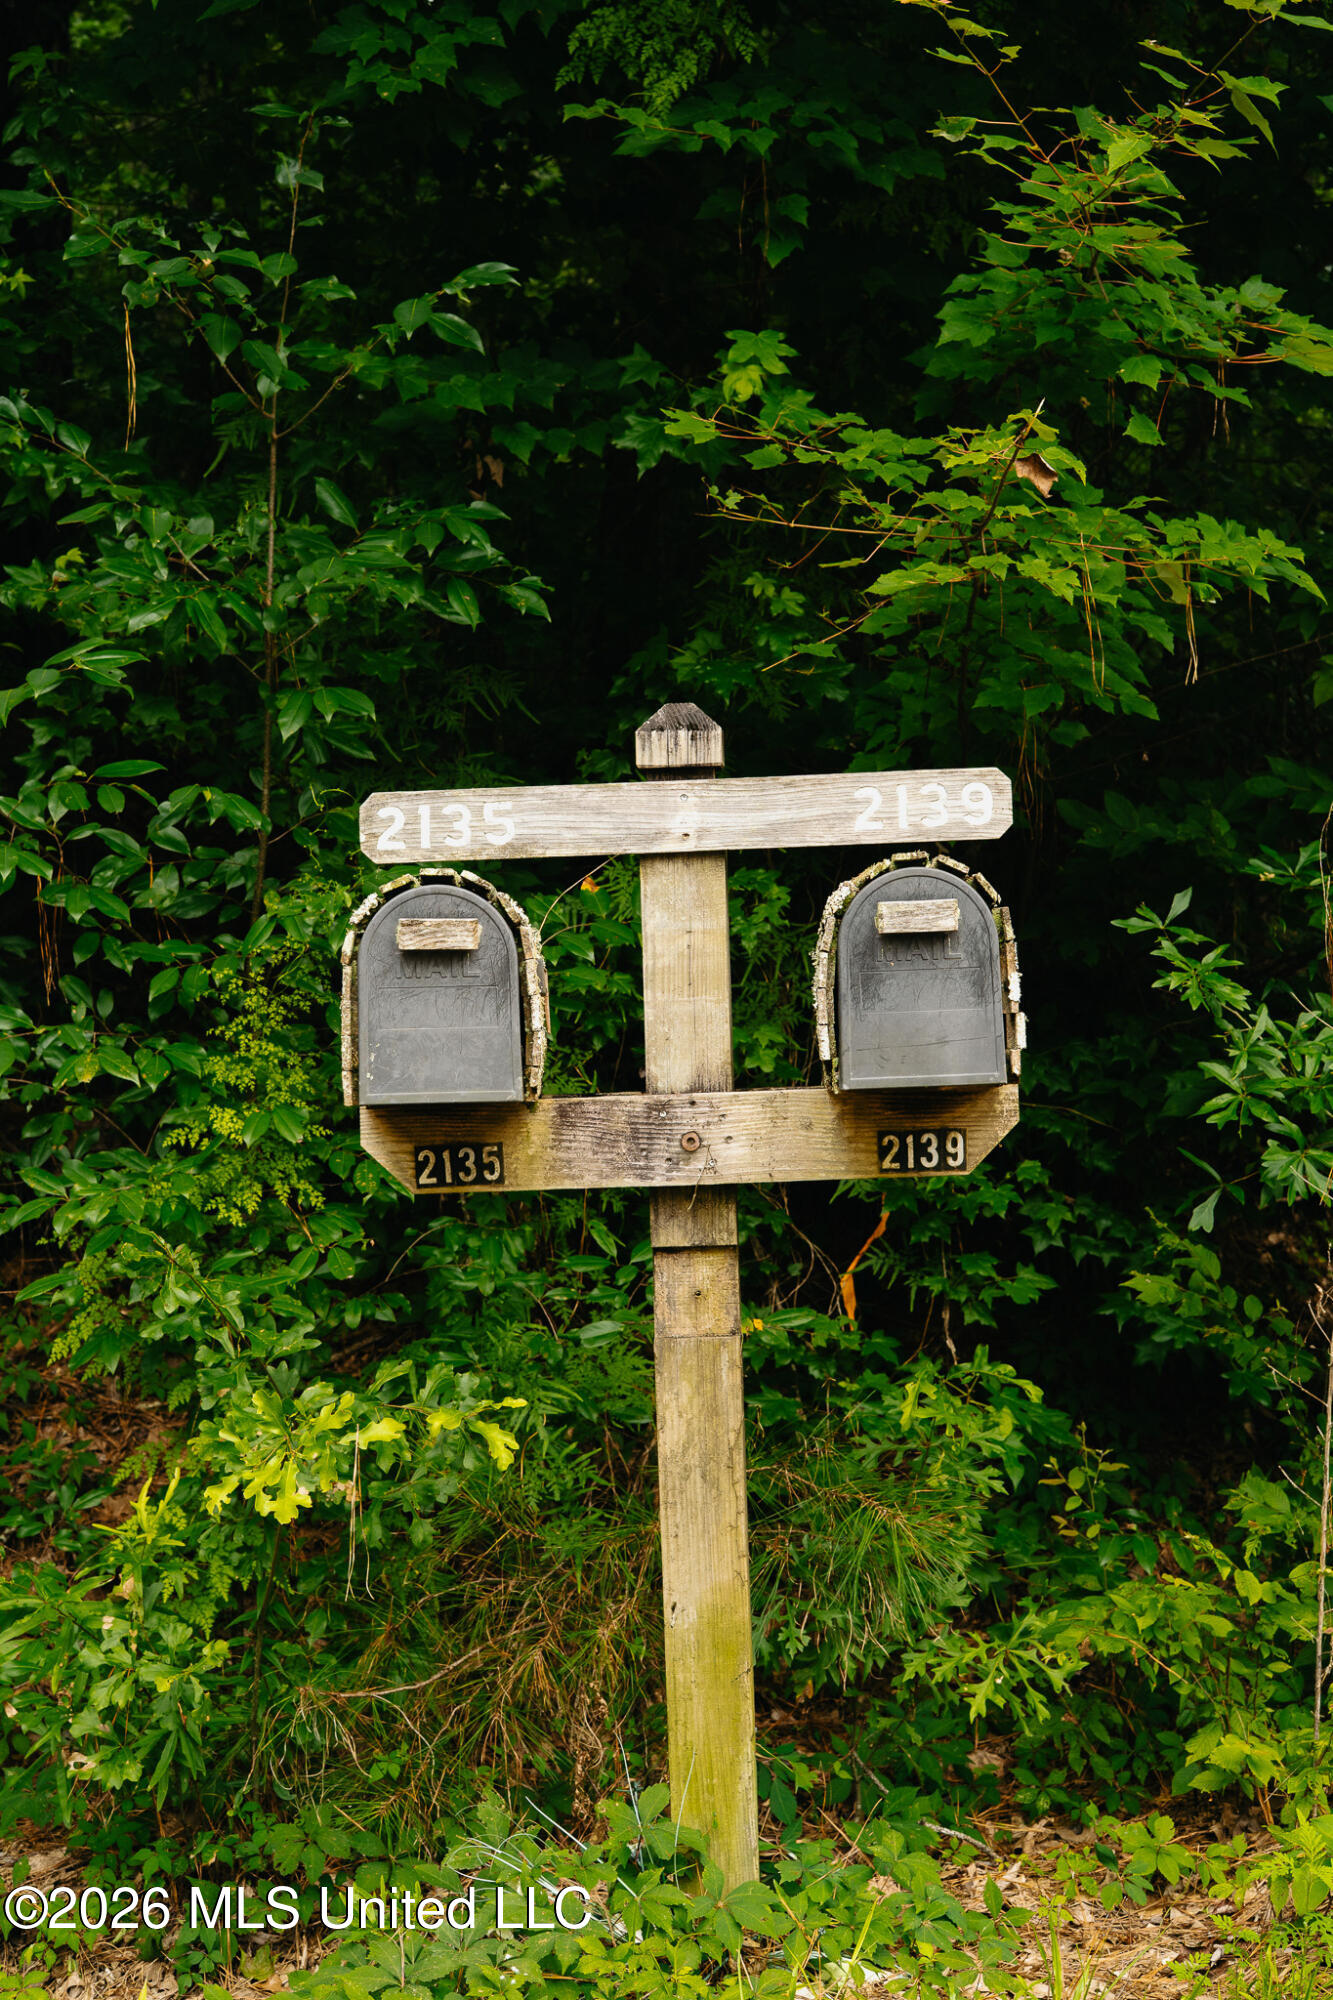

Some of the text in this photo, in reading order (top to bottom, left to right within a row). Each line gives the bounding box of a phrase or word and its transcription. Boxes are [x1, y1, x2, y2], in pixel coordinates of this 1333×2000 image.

[376, 801, 515, 851] 2135
[853, 782, 993, 832] 2139
[396, 951, 480, 980] MAIL
[876, 932, 961, 963] MAIL
[417, 1145, 501, 1185] 2135
[881, 1131, 965, 1169] 2139
